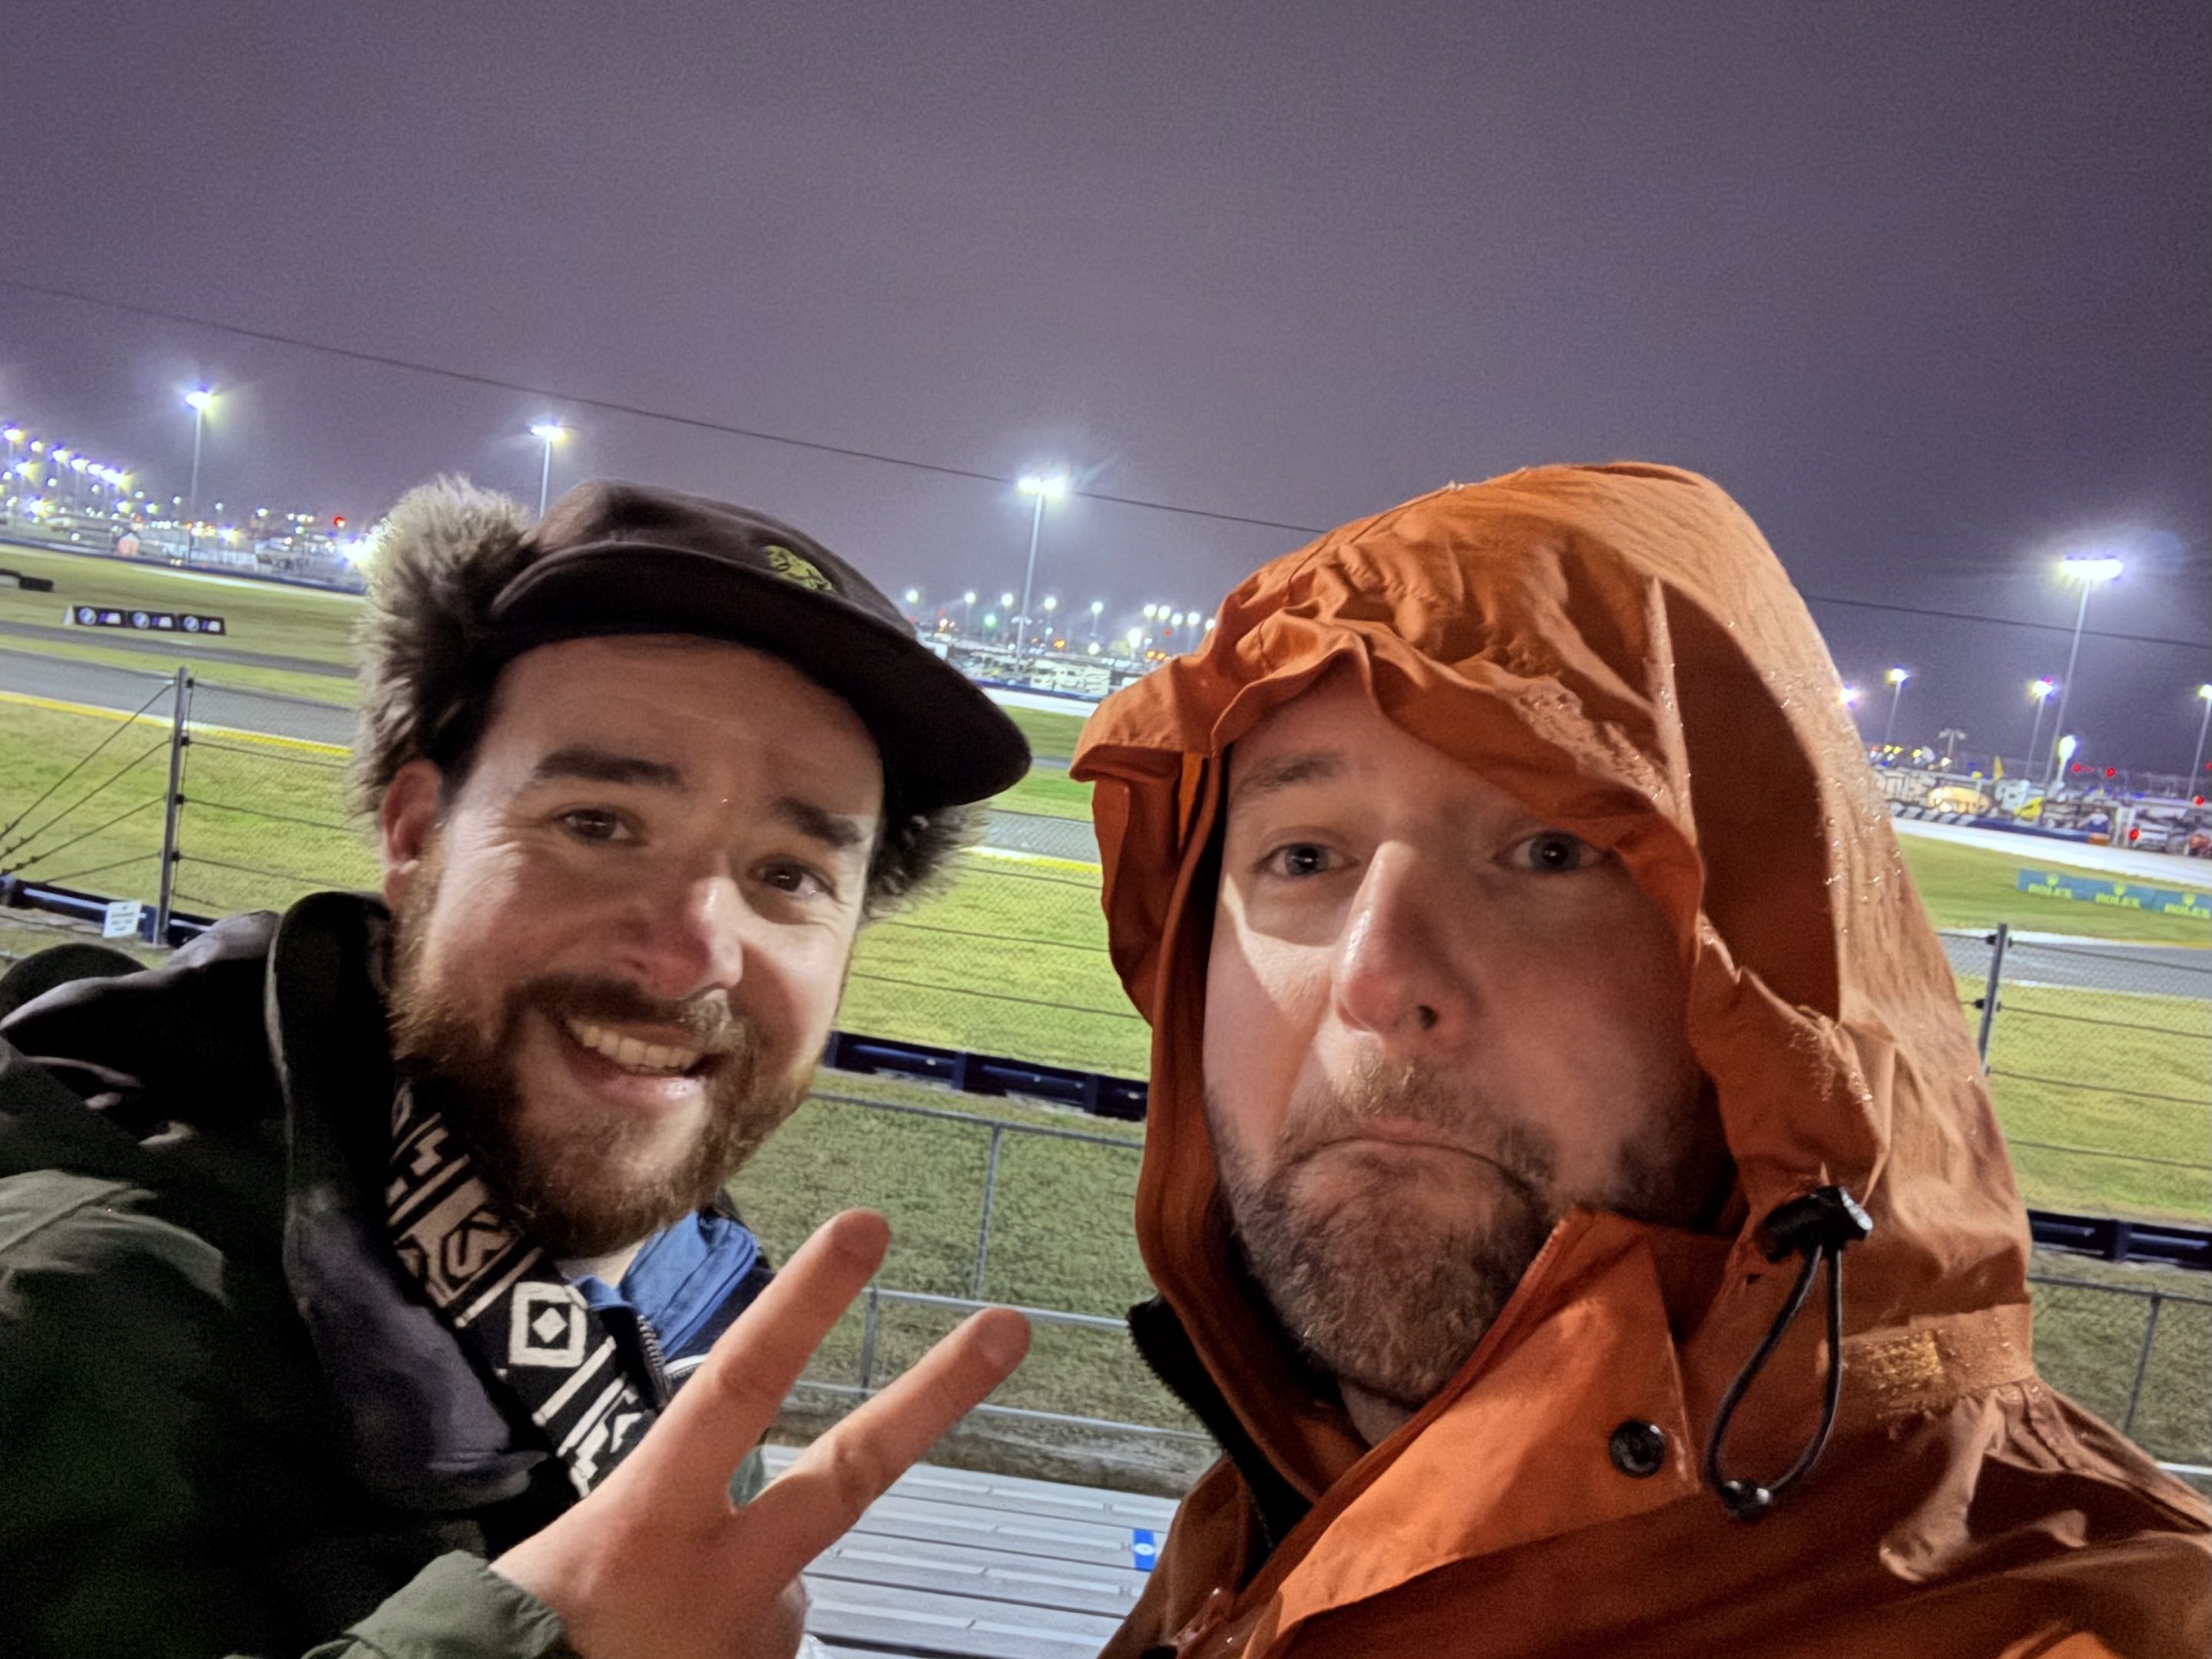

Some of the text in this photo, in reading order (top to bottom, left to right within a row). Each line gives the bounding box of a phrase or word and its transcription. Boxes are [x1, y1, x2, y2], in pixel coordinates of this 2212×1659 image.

[2028, 882, 2073, 899] ROLEX
[2095, 892, 2141, 909] ROLEX
[2164, 902, 2210, 919] ROLEX
